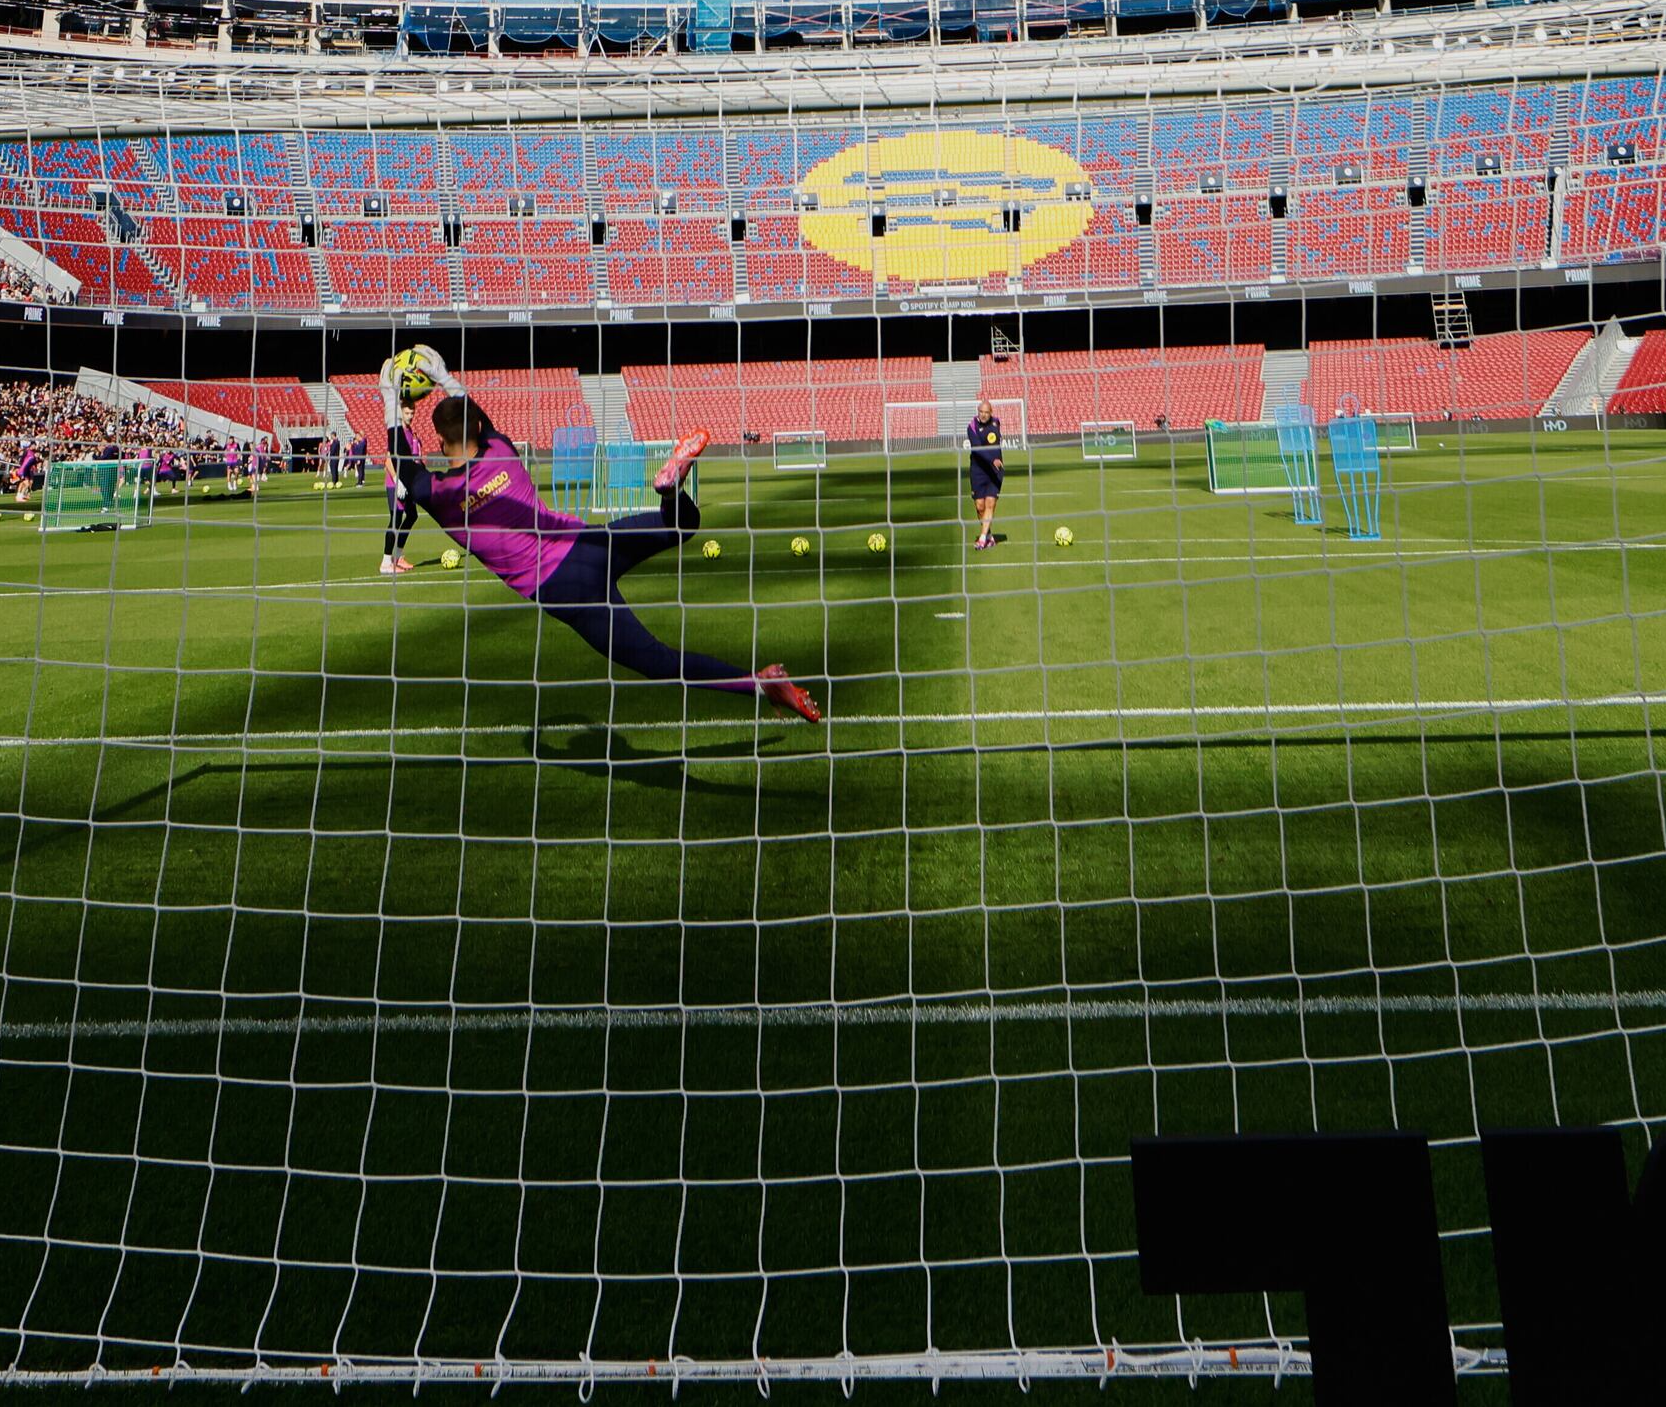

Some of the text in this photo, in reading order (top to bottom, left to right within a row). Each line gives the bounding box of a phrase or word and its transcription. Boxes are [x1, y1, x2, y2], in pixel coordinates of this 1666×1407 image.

[1348, 281, 1374, 294] PRIME
[1454, 275, 1482, 288] PRIME
[1043, 295, 1067, 307] PRIME
[23, 306, 43, 321] PRIME
[609, 309, 633, 321] PRIME
[709, 306, 733, 319] PRIME
[808, 303, 832, 316] PRIME
[196, 315, 221, 328] PRIME
[1543, 420, 1567, 432] HMD
[477, 471, 509, 499] CONGO
